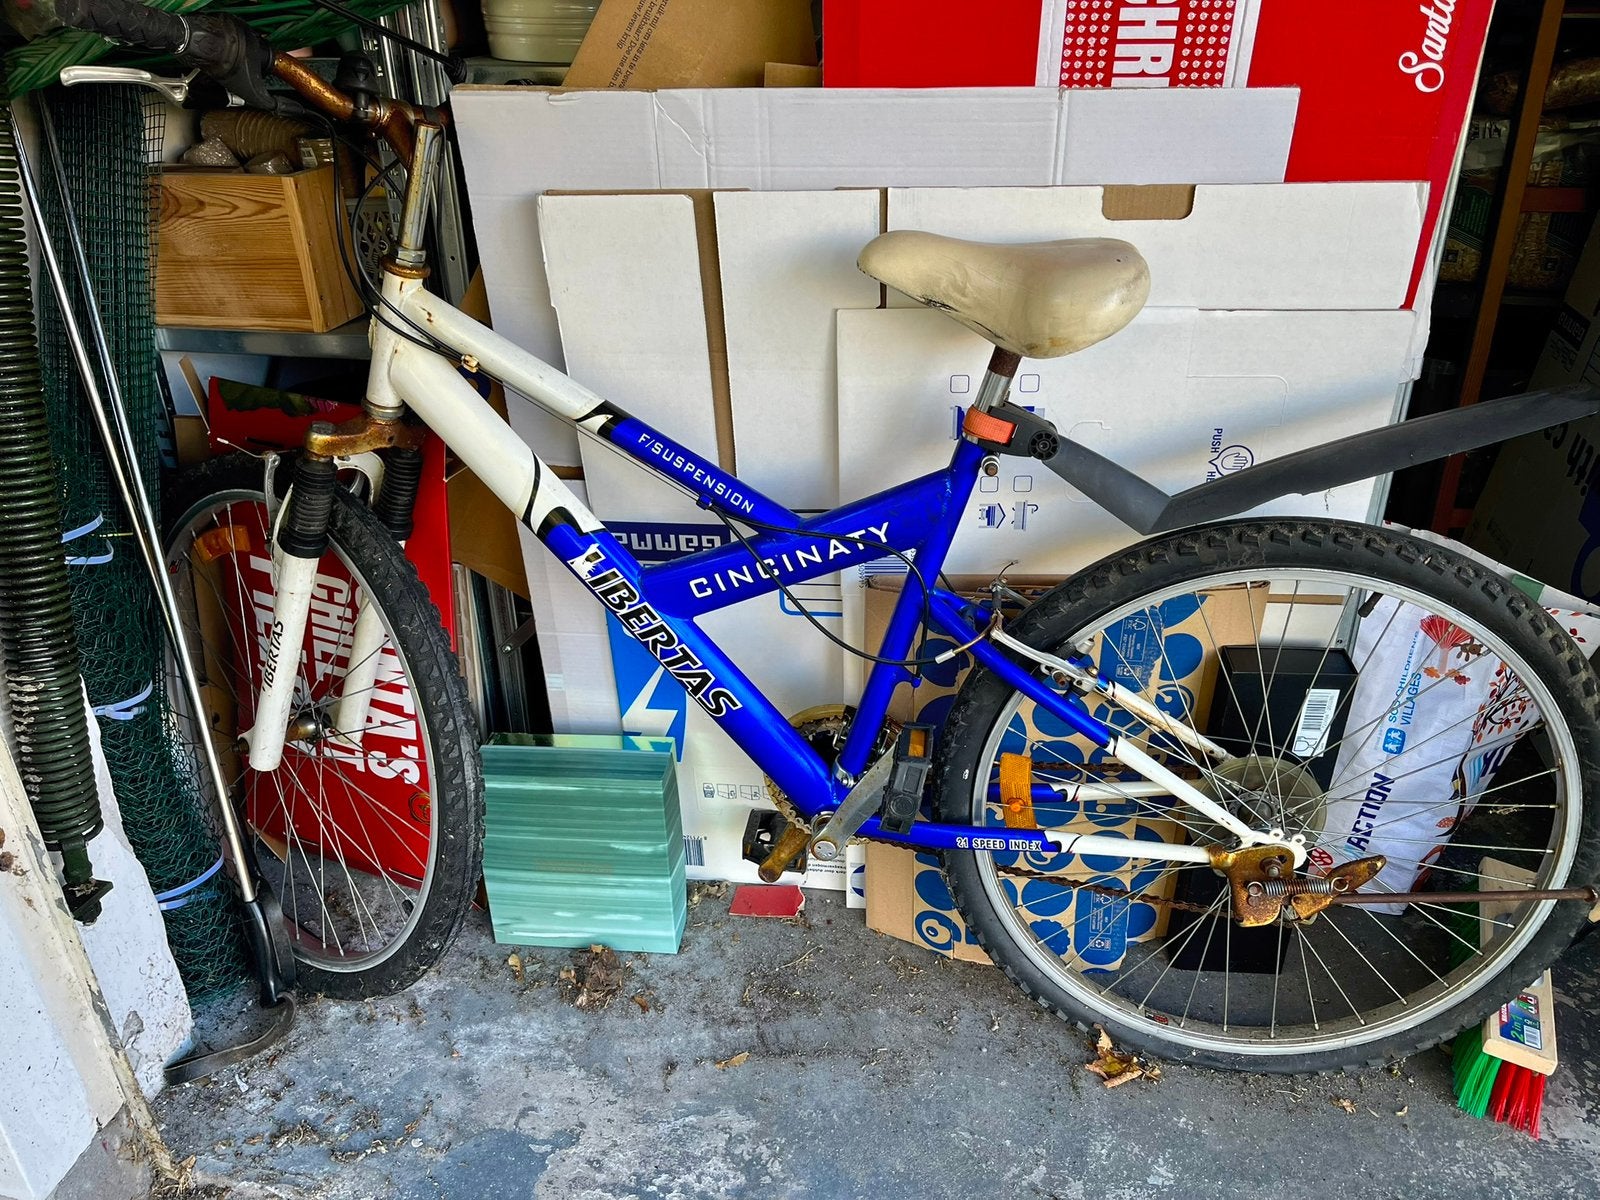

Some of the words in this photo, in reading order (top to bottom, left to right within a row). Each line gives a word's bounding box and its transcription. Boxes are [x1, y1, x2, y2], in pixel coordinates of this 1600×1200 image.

[1110, 0, 1180, 88] HRI
[637, 432, 755, 514] F/SUSPENSION
[1210, 428, 1223, 453] PUSH
[689, 521, 893, 599] CINCINATY
[261, 618, 285, 692] IBERTAS
[571, 542, 742, 718] LIBERTAS
[1400, 672, 1423, 726] VILLAGES
[955, 838, 969, 850] 21
[972, 838, 1006, 851] SPEED
[1008, 839, 1042, 852] INDEX
[1347, 772, 1396, 853] ACTION
